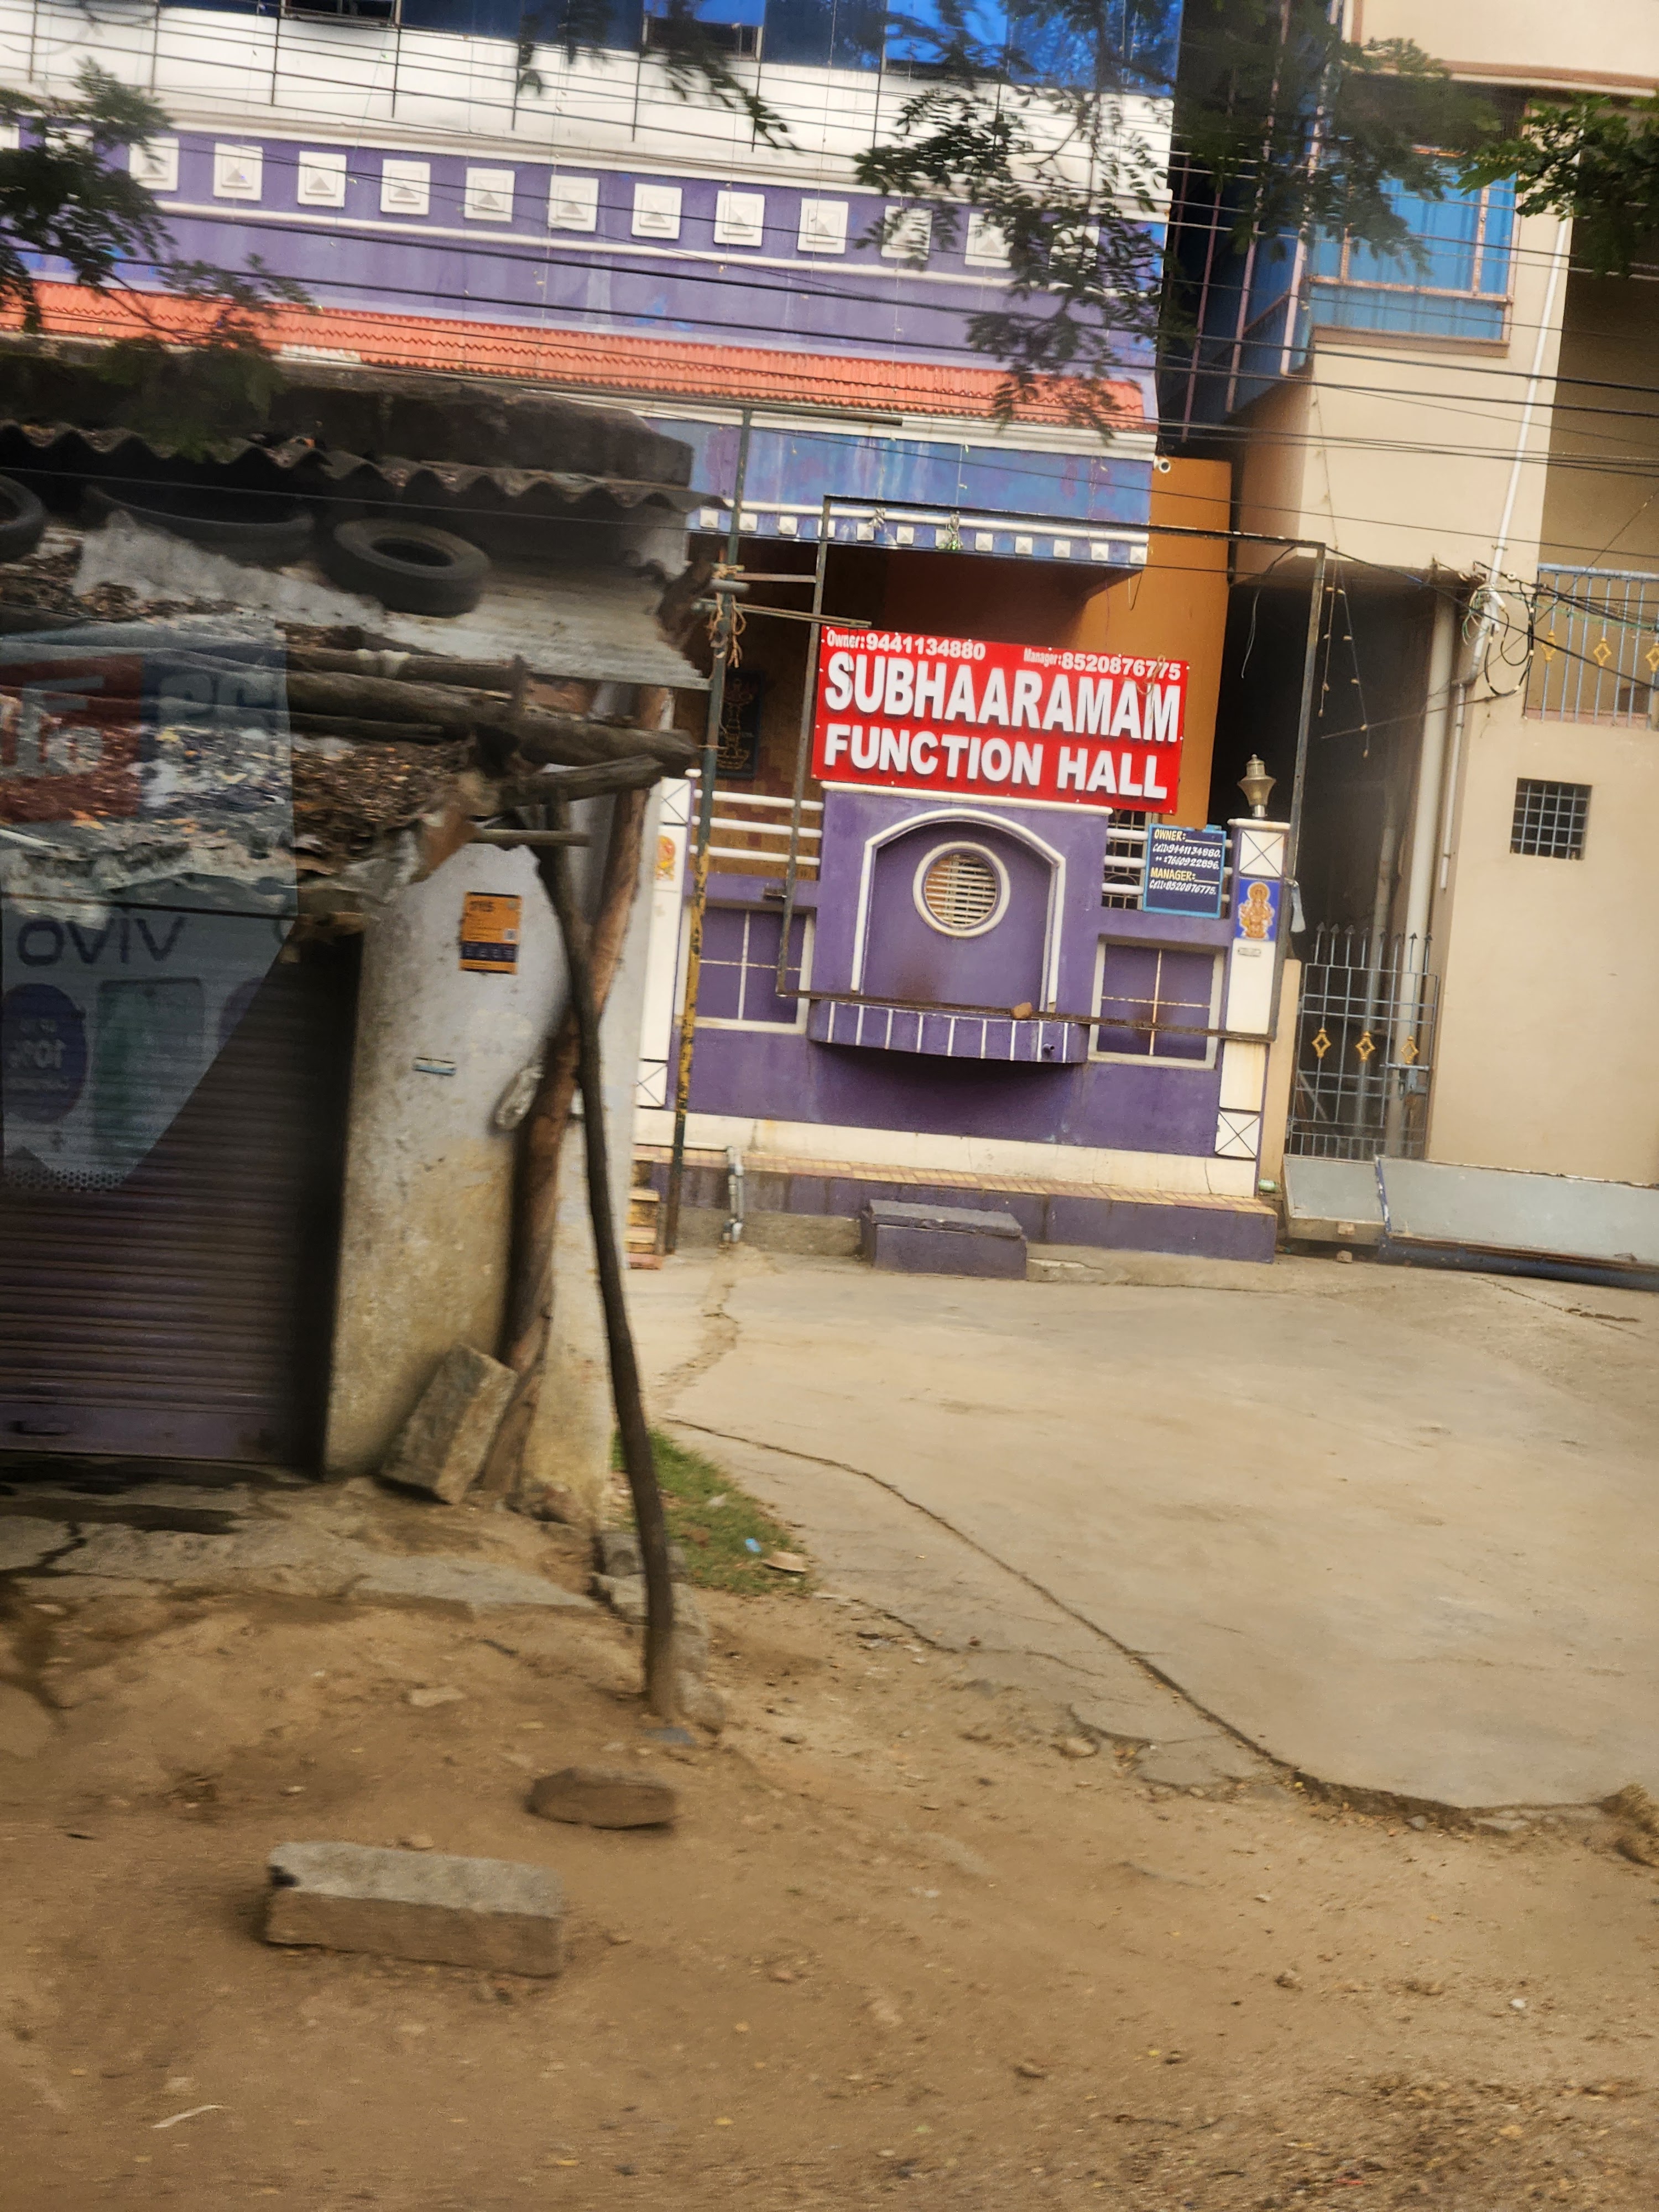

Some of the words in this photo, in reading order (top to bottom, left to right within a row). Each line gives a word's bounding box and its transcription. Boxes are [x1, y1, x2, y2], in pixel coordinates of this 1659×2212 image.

[825, 651, 1181, 742] SUBHAARAMAM
[824, 723, 1044, 786] FUNCTION
[1057, 747, 1167, 799] HALL
[1154, 828, 1186, 842] OWNER:
[1150, 867, 1196, 881] MANAGER:
